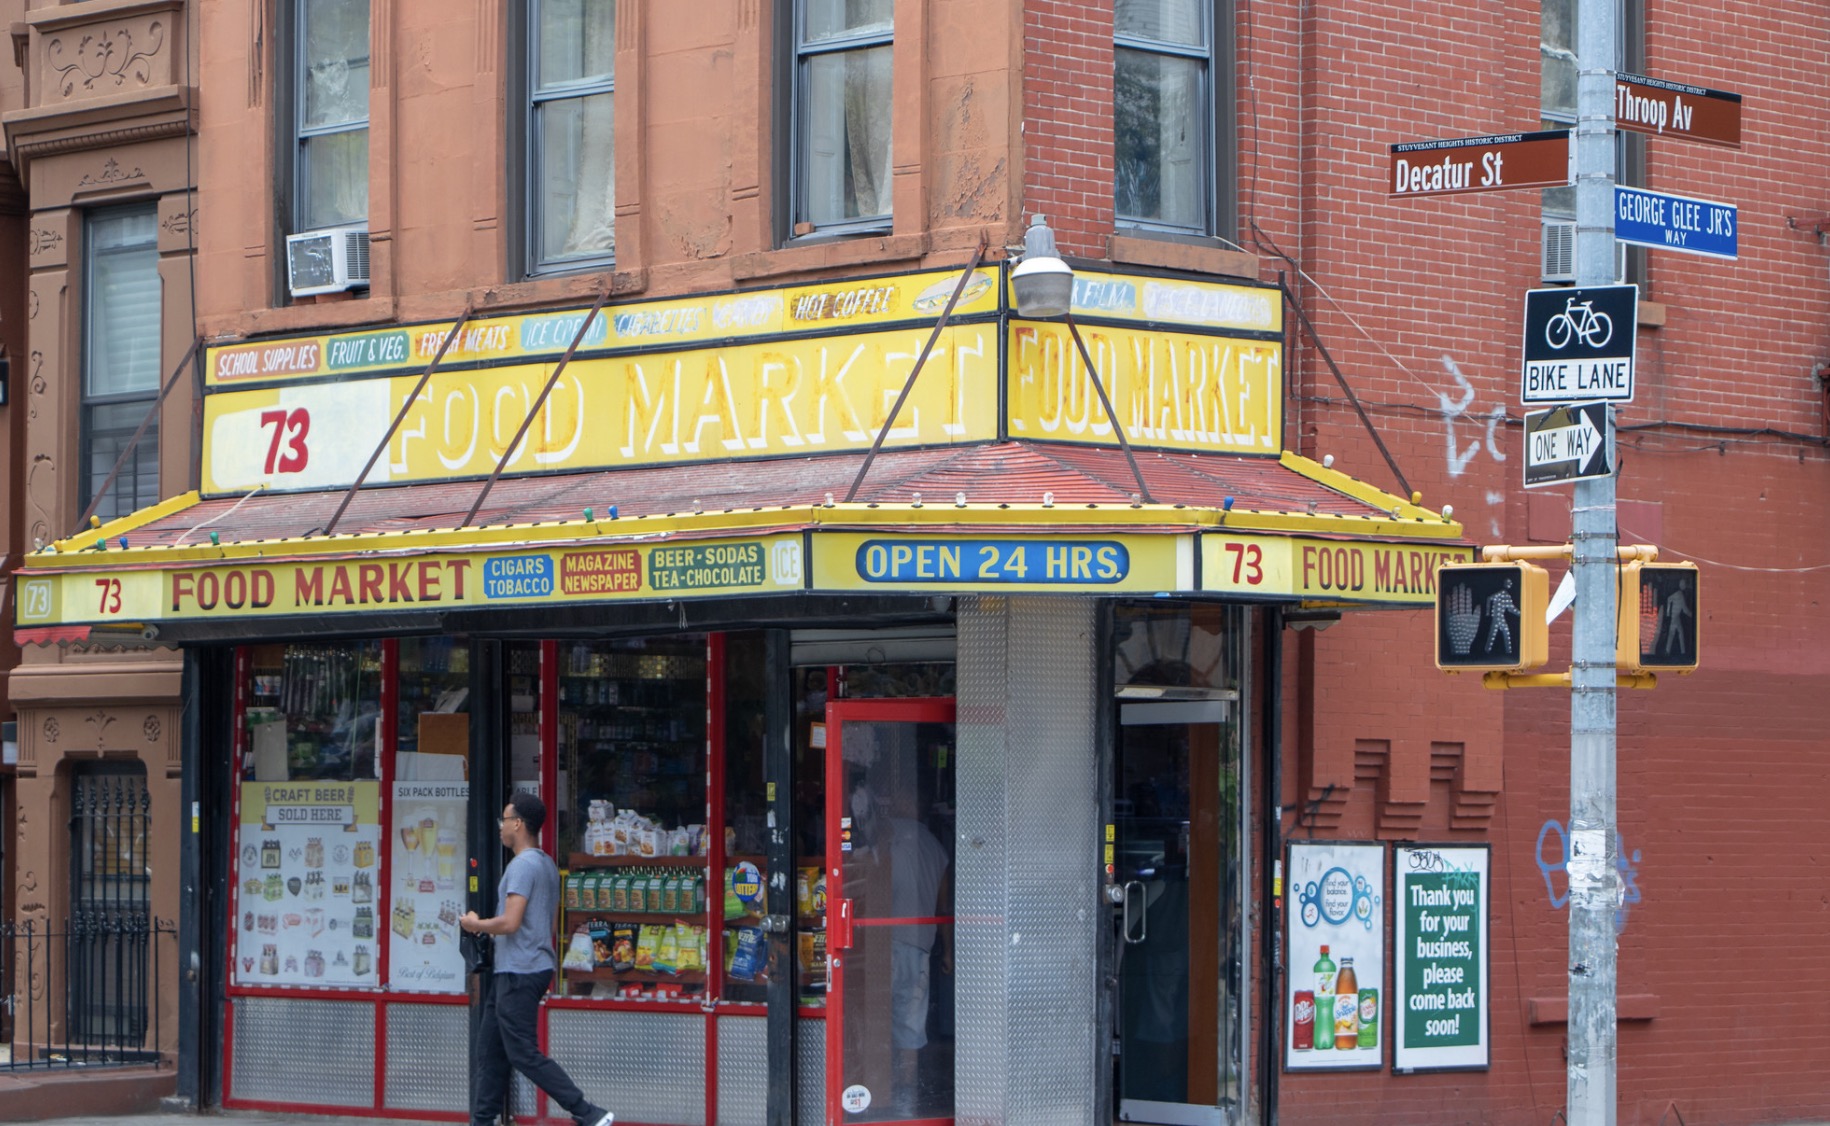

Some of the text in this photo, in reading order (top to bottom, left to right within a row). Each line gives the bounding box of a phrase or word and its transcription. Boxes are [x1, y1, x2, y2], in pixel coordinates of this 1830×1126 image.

[1646, 78, 1665, 88] HEIGHTS
[1666, 81, 1686, 92] HISTORIC
[1686, 86, 1707, 95] DISTRICT
[1617, 84, 1693, 133] Throop Av
[1397, 134, 1522, 152] STUYVESANT HEIGHTS HISTORIC DISTRICT
[1395, 151, 1503, 193] Decatur St
[1619, 192, 1733, 238] GEORGE GLEE JR'S
[1665, 229, 1687, 246] WAY
[795, 286, 895, 321] HOT COFFEE
[464, 325, 510, 353] MEATS
[525, 320, 551, 346] ICE
[218, 344, 318, 377] SCHOOL SUPPLIES
[330, 336, 405, 365] FRUIT & VEG.
[1012, 326, 1279, 448] FOOD MARKET
[1529, 362, 1626, 391] BIKE LANE
[390, 332, 984, 476] FOOD MARKET
[261, 407, 310, 475] 73
[1535, 427, 1593, 462] ONE WAY
[491, 557, 545, 576] CIGARS
[565, 552, 634, 573] MAGAZINE
[774, 545, 798, 579] ICE
[865, 545, 1122, 579] OPEN 24 HRS.
[1224, 542, 1264, 585] 73
[1302, 545, 1466, 595] FOOD MARK
[95, 578, 122, 614] 73
[172, 558, 472, 612] FOOD MARKET
[488, 577, 550, 596] TOBACCO
[564, 572, 638, 593] NEWSPAPER
[272, 788, 346, 802] CRAFT BEER
[398, 787, 470, 797] SIX PACK BOTTLES
[278, 808, 342, 821] SOLD HERE
[1337, 881, 1349, 889] your
[1410, 884, 1475, 911] Thank you
[1419, 911, 1470, 938] for your
[1416, 936, 1473, 960] business,
[1423, 962, 1464, 989] please
[1409, 986, 1476, 1010] come back
[1425, 1013, 1461, 1037] soon!
